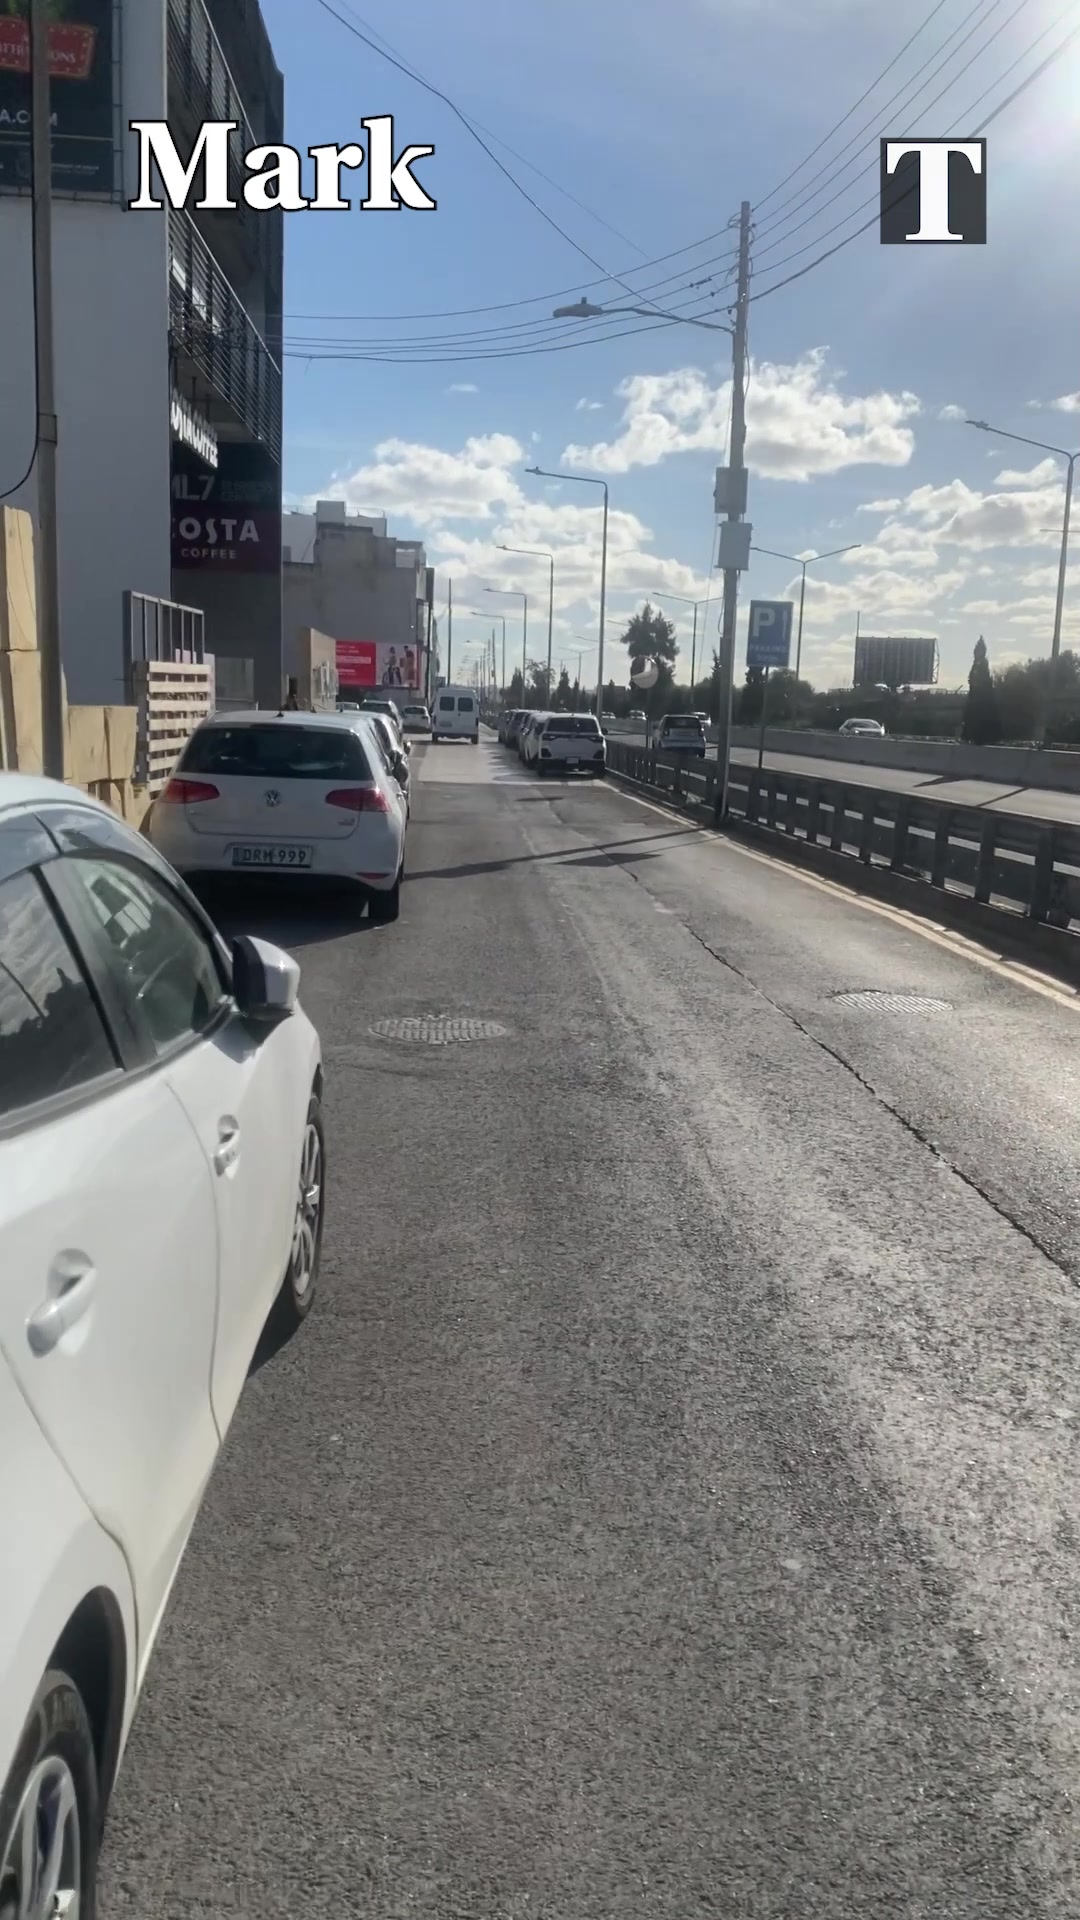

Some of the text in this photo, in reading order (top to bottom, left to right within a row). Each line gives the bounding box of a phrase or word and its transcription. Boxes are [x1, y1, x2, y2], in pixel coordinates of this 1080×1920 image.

[172, 516, 260, 544] OSTA
[181, 548, 237, 559] COFFEE
[752, 607, 775, 637] P
[279, 850, 306, 863] 999
